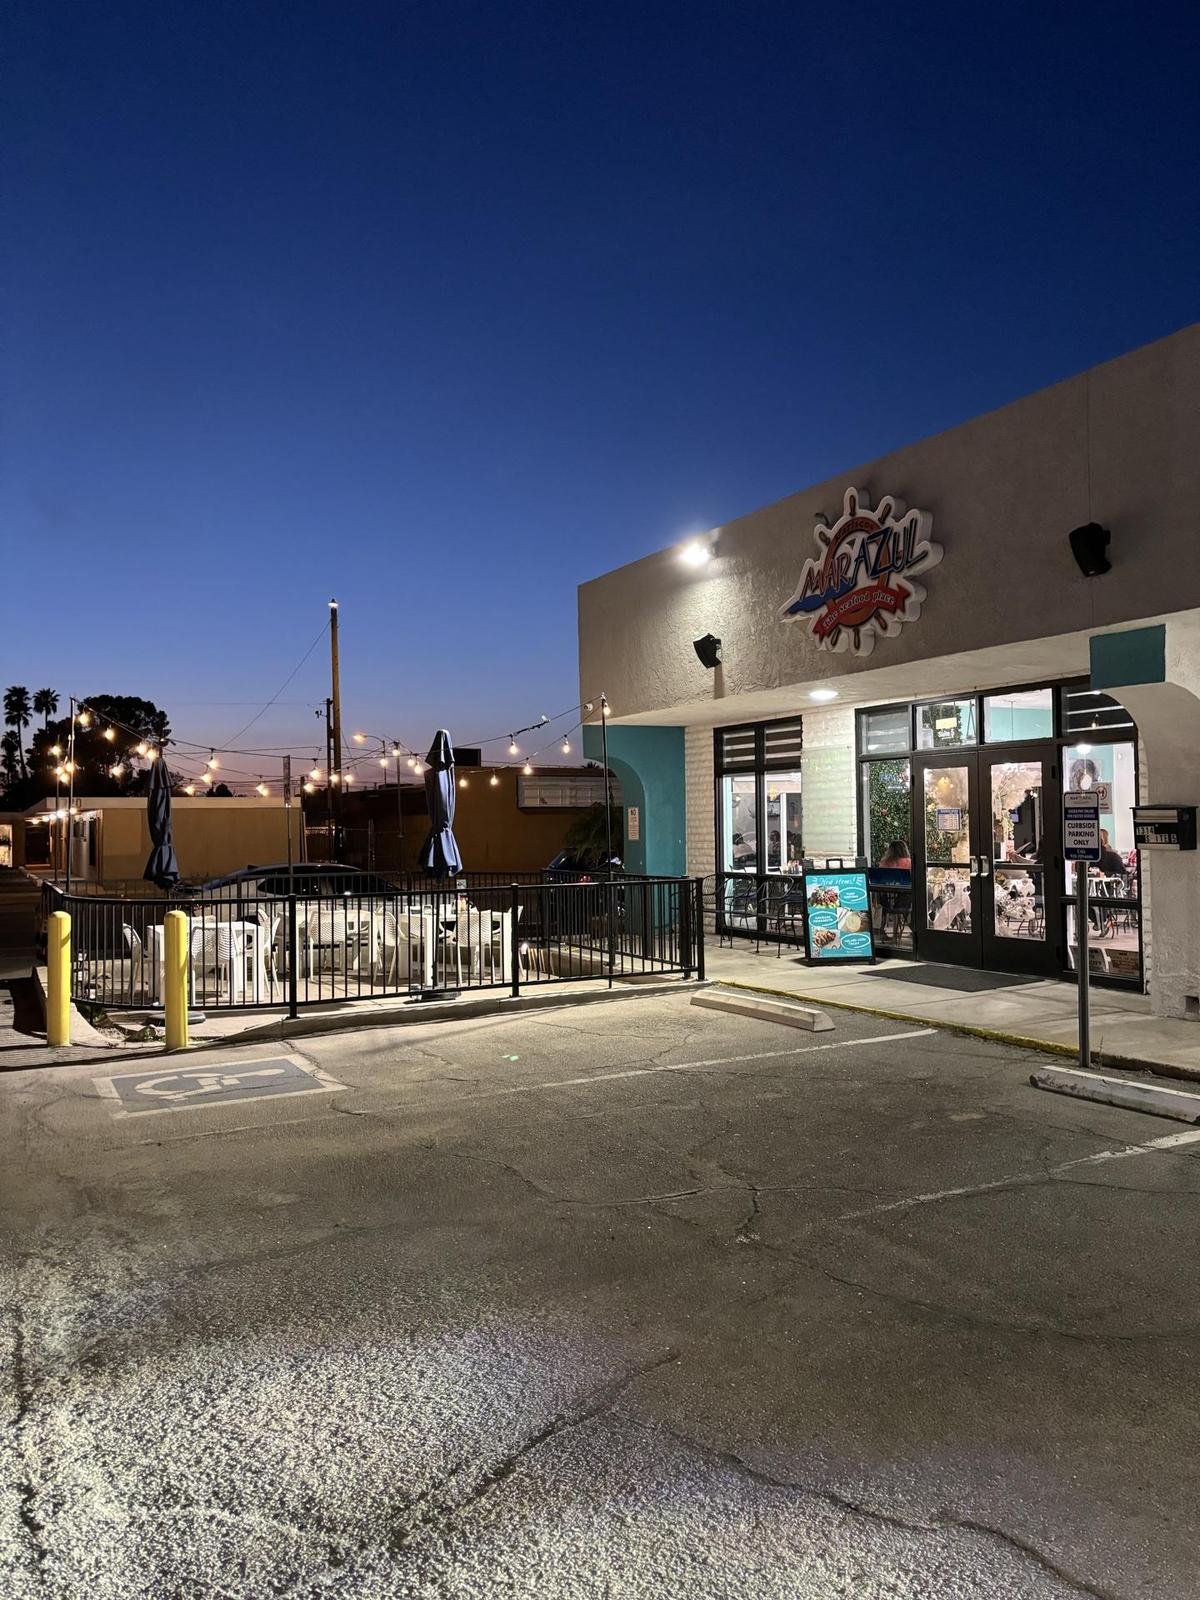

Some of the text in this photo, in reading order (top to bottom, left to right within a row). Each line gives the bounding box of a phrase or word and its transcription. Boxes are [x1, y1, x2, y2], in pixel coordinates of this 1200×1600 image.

[799, 517, 929, 602] MAR AZUL
[838, 592, 871, 613] seafood
[872, 590, 895, 606] place
[1136, 826, 1154, 835] 1314
